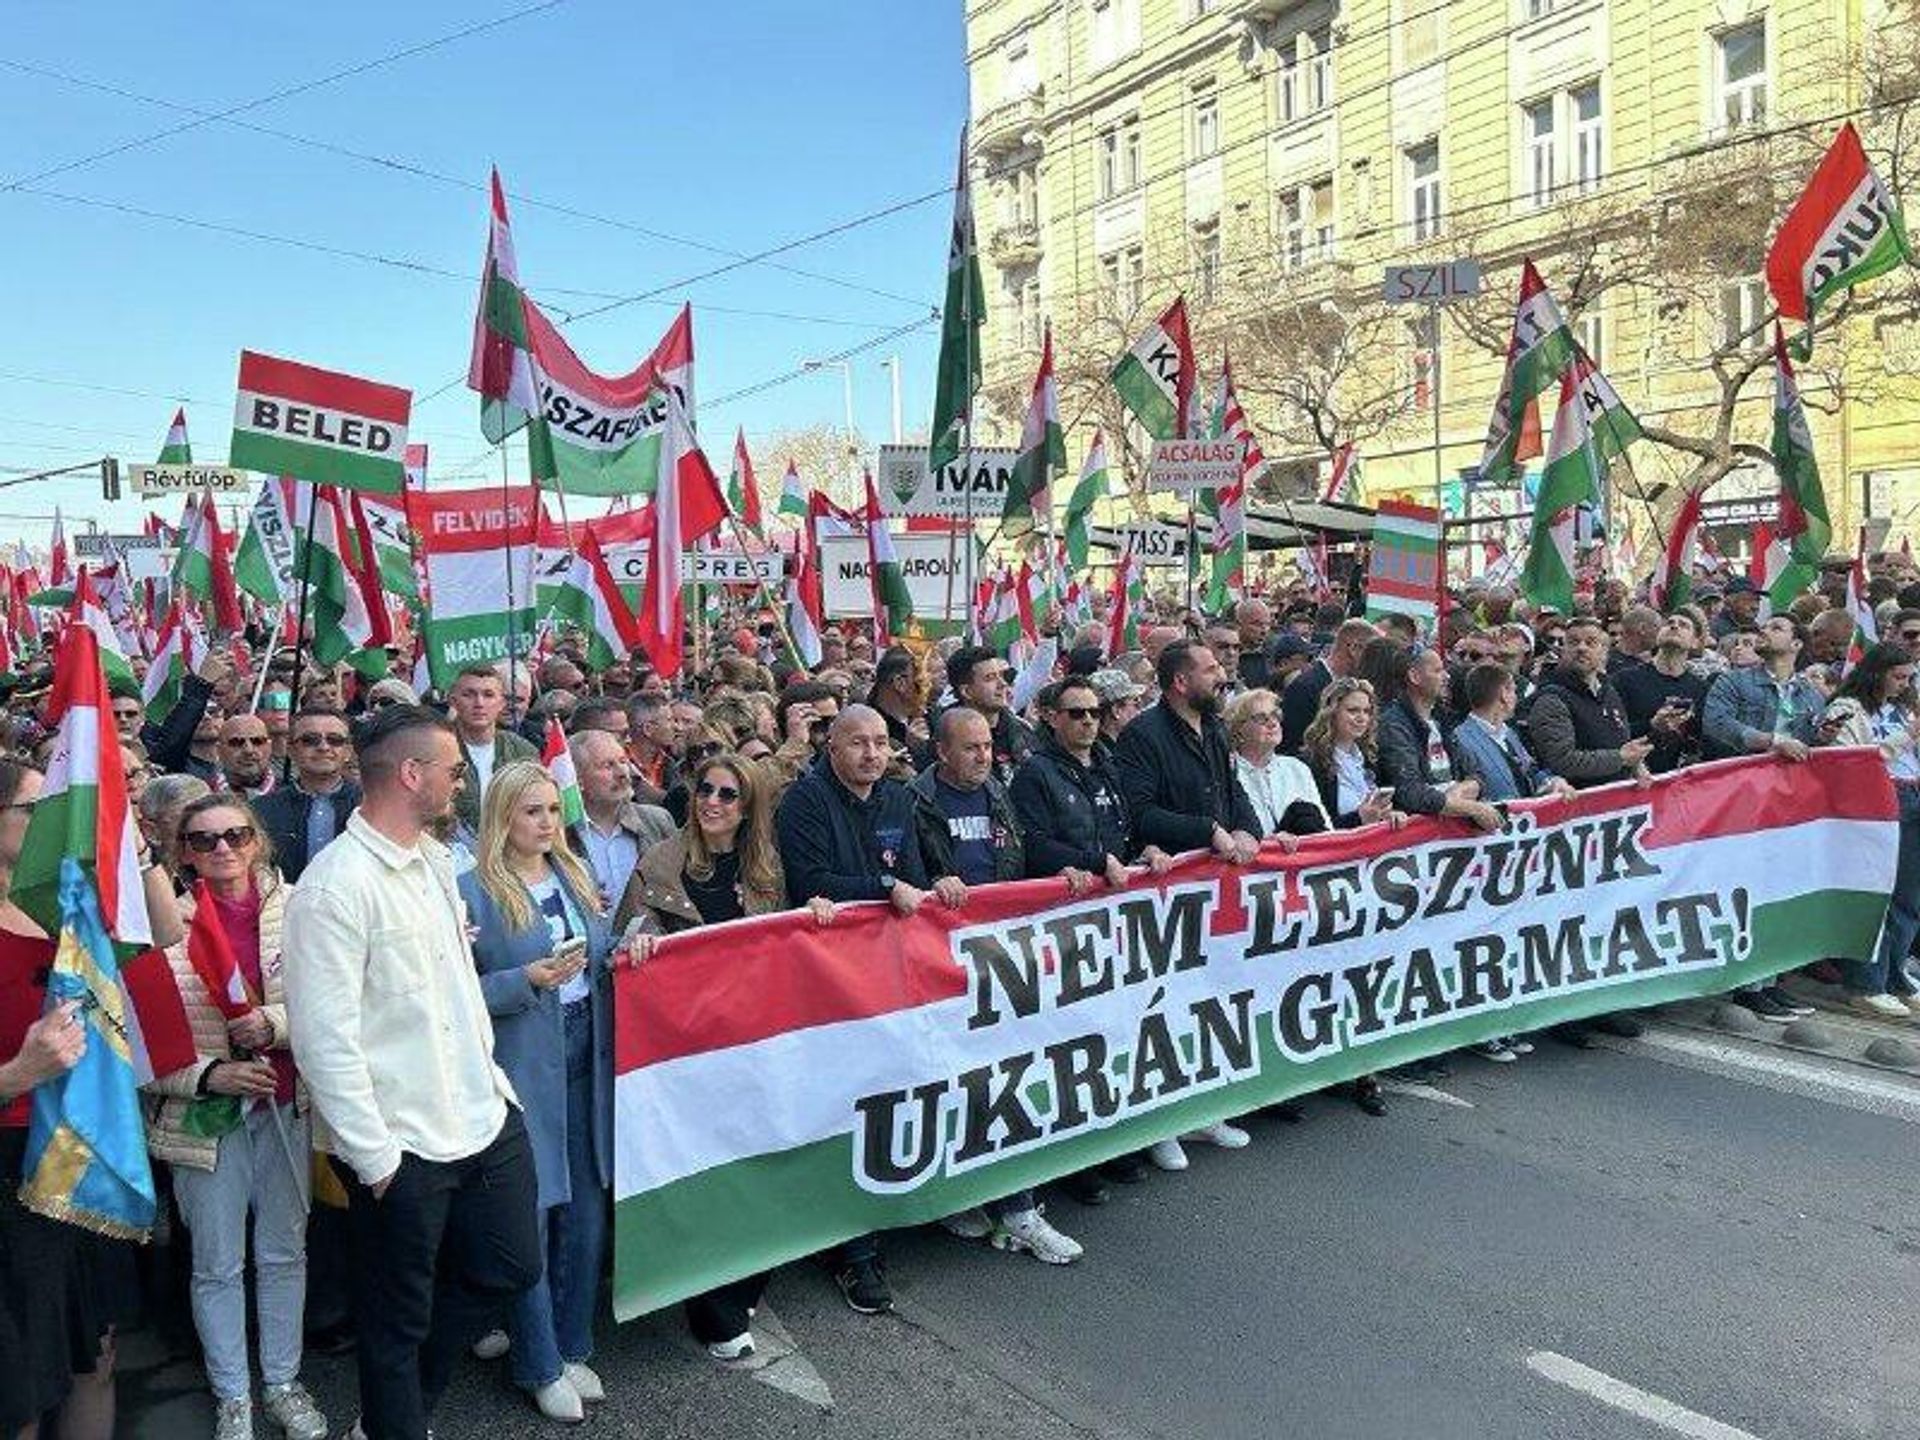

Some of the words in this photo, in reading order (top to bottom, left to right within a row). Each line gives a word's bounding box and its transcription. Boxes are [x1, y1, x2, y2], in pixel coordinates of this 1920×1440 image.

[1399, 266, 1468, 298] SZIL
[252, 399, 392, 451] BELED
[1158, 444, 1236, 463] ACSALAG
[143, 469, 237, 490] Révfülöp
[936, 461, 1011, 492] IVÁN
[1127, 530, 1170, 555] TASS
[624, 559, 770, 577] CPREG
[961, 891, 1212, 1031] NEM
[1242, 808, 1662, 959] LESZÜNK
[855, 987, 1255, 1183] UKRÁN
[1279, 888, 1752, 1054] GYARMAT!
